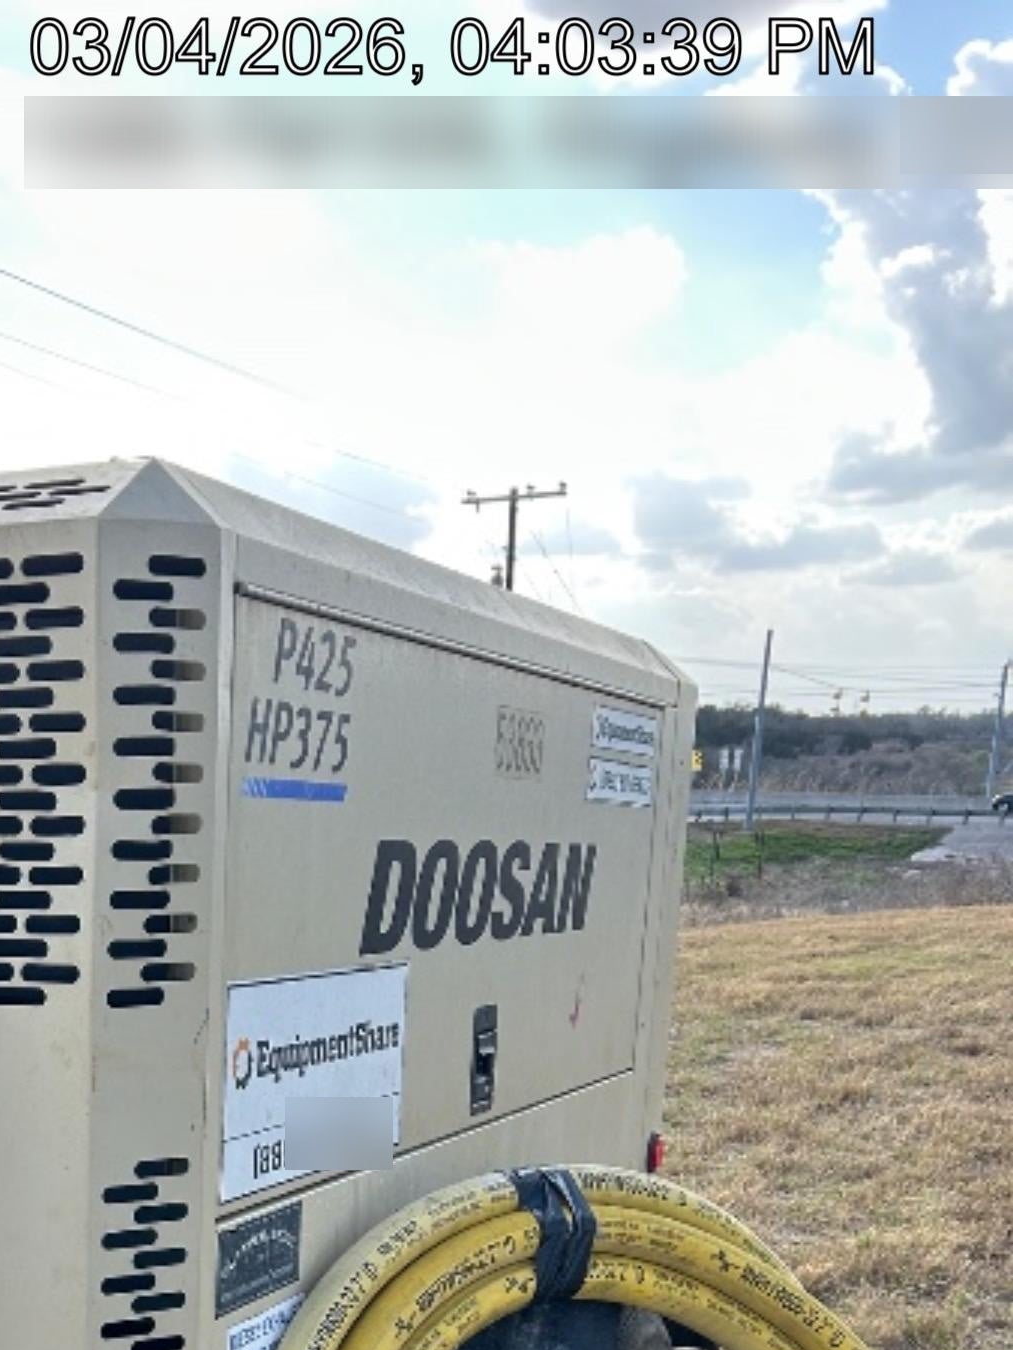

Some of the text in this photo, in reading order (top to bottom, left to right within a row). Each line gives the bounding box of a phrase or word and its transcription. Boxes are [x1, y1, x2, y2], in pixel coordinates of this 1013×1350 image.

[273, 617, 357, 697] P425
[245, 696, 351, 773] HP375
[359, 839, 597, 957] DOOSAN
[257, 1020, 399, 1083] EquipmentShare
